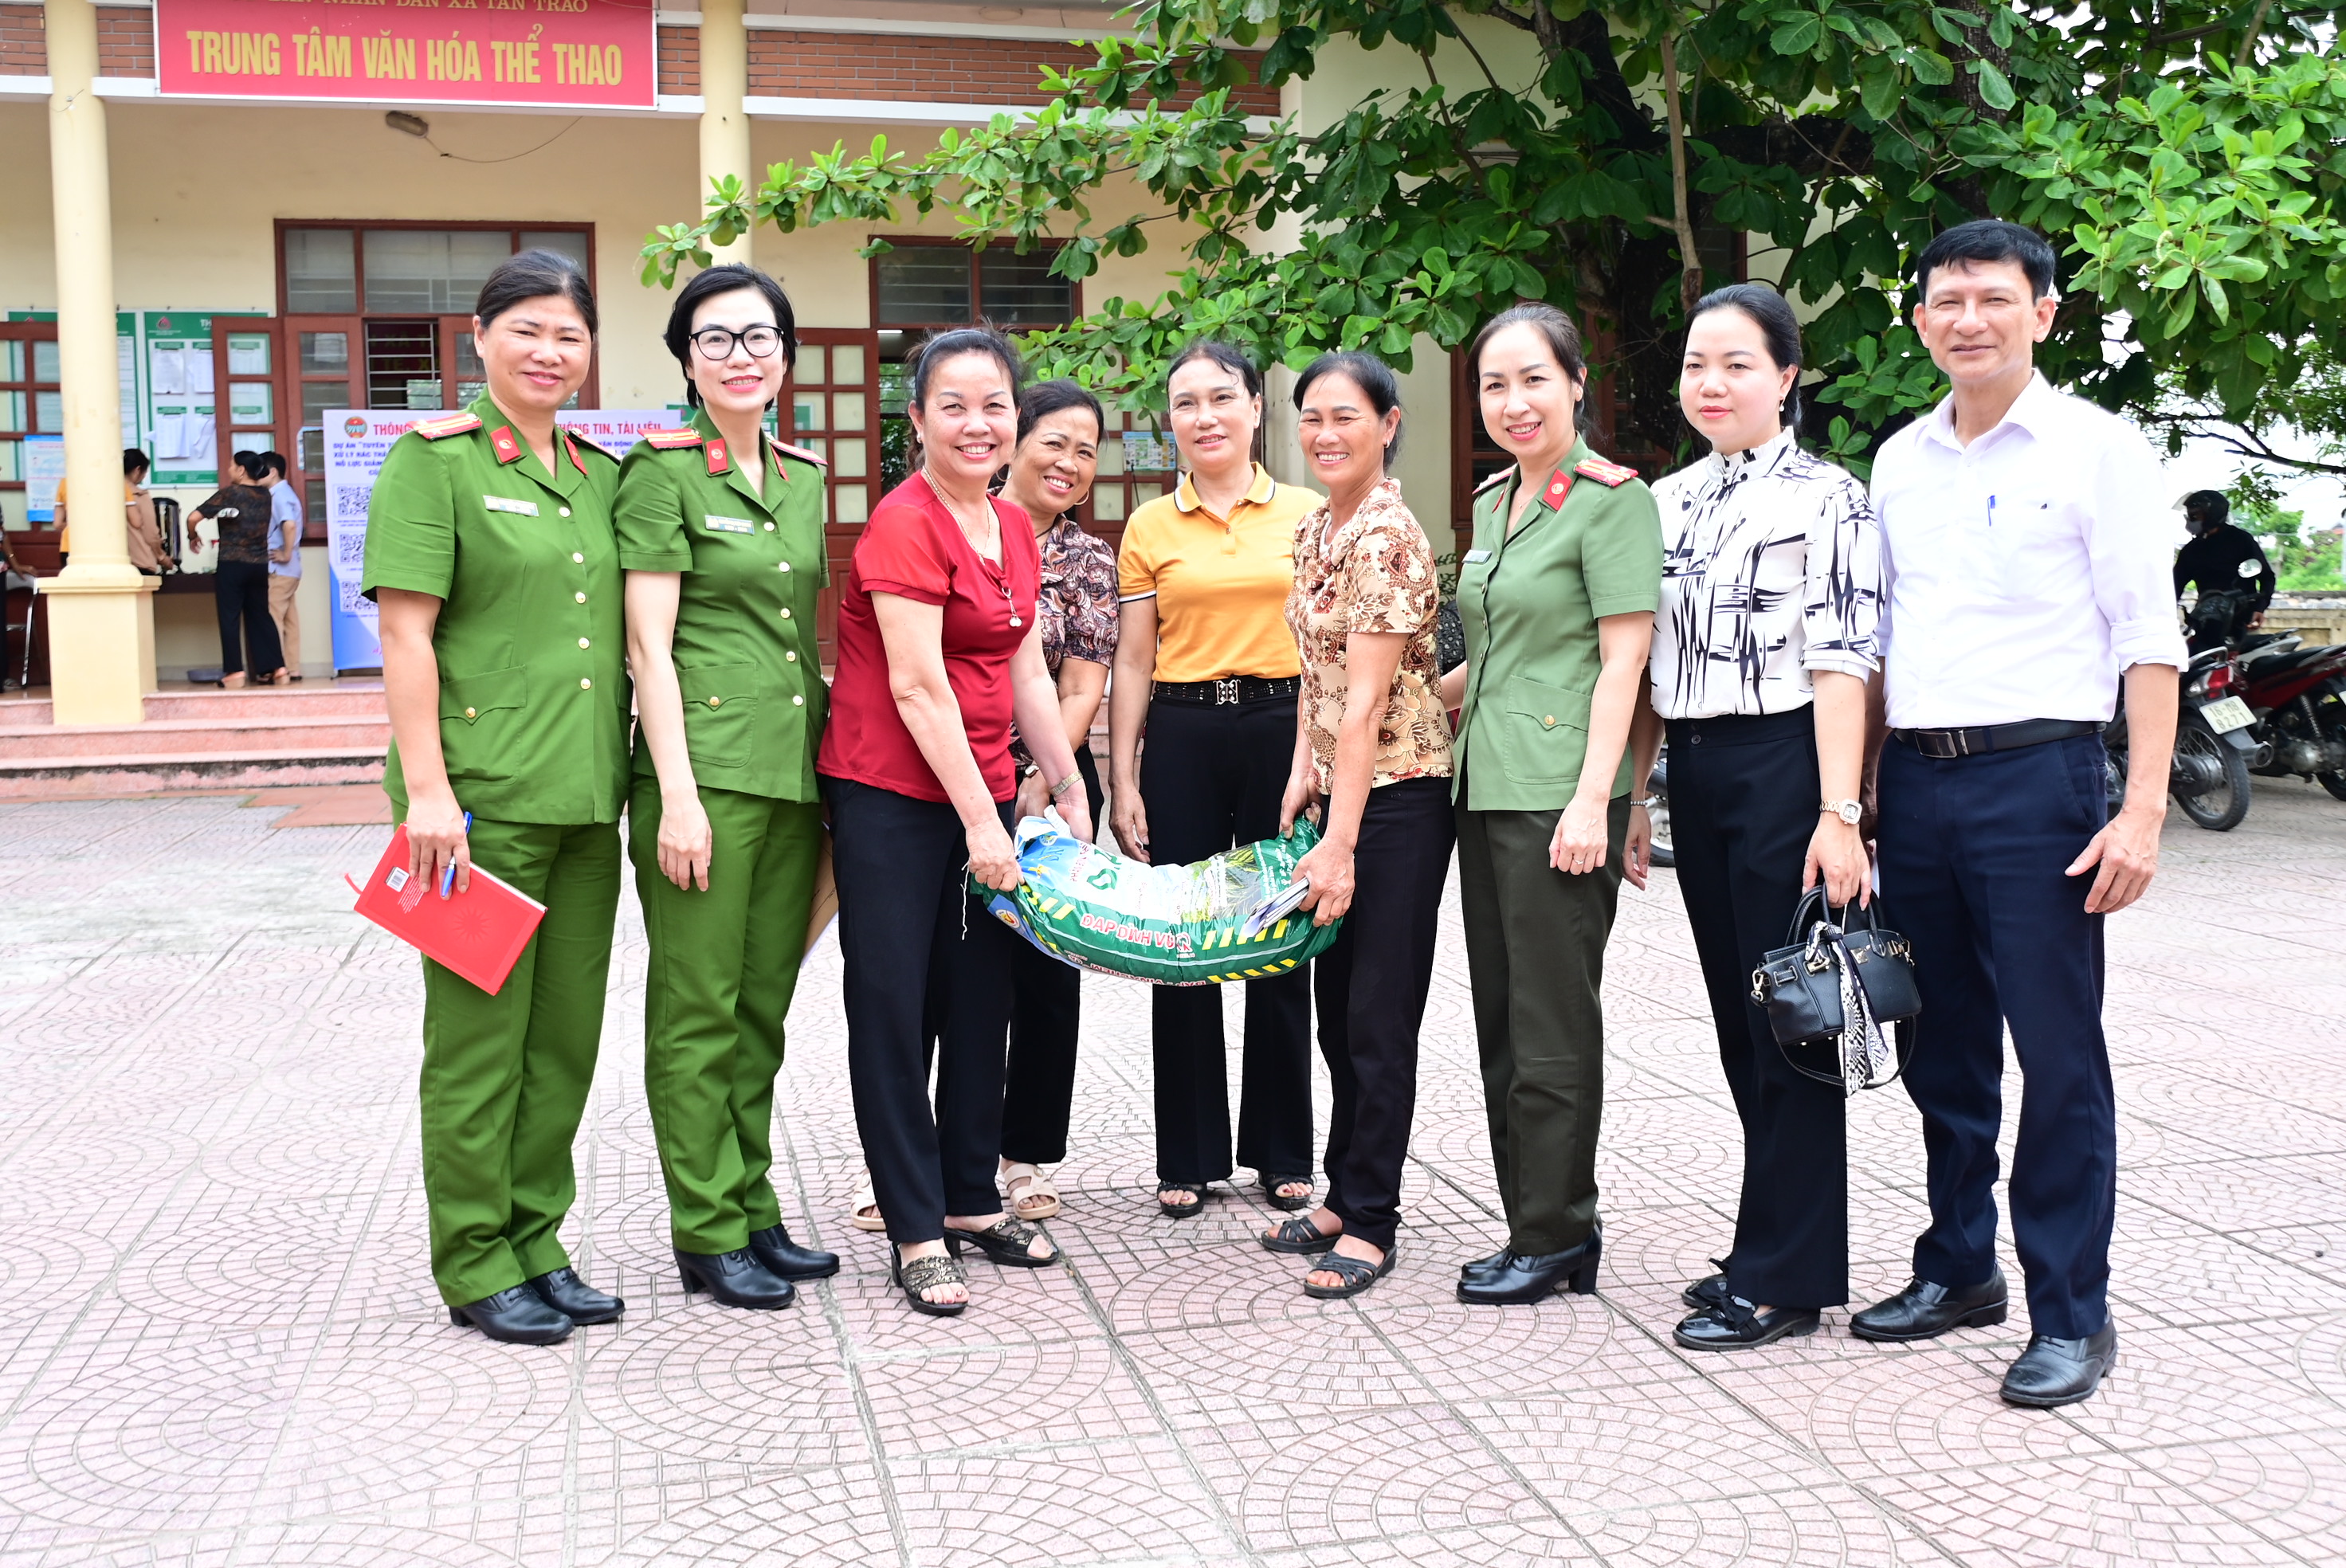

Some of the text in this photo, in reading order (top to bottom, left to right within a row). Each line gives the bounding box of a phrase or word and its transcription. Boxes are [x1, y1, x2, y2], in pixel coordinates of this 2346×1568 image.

[186, 23, 622, 86] TRUNG TÂM VĂN HÓA THỂ THAO
[593, 423, 614, 435] TIN,
[2216, 711, 2249, 729] 8271
[1080, 913, 1117, 935] DAP
